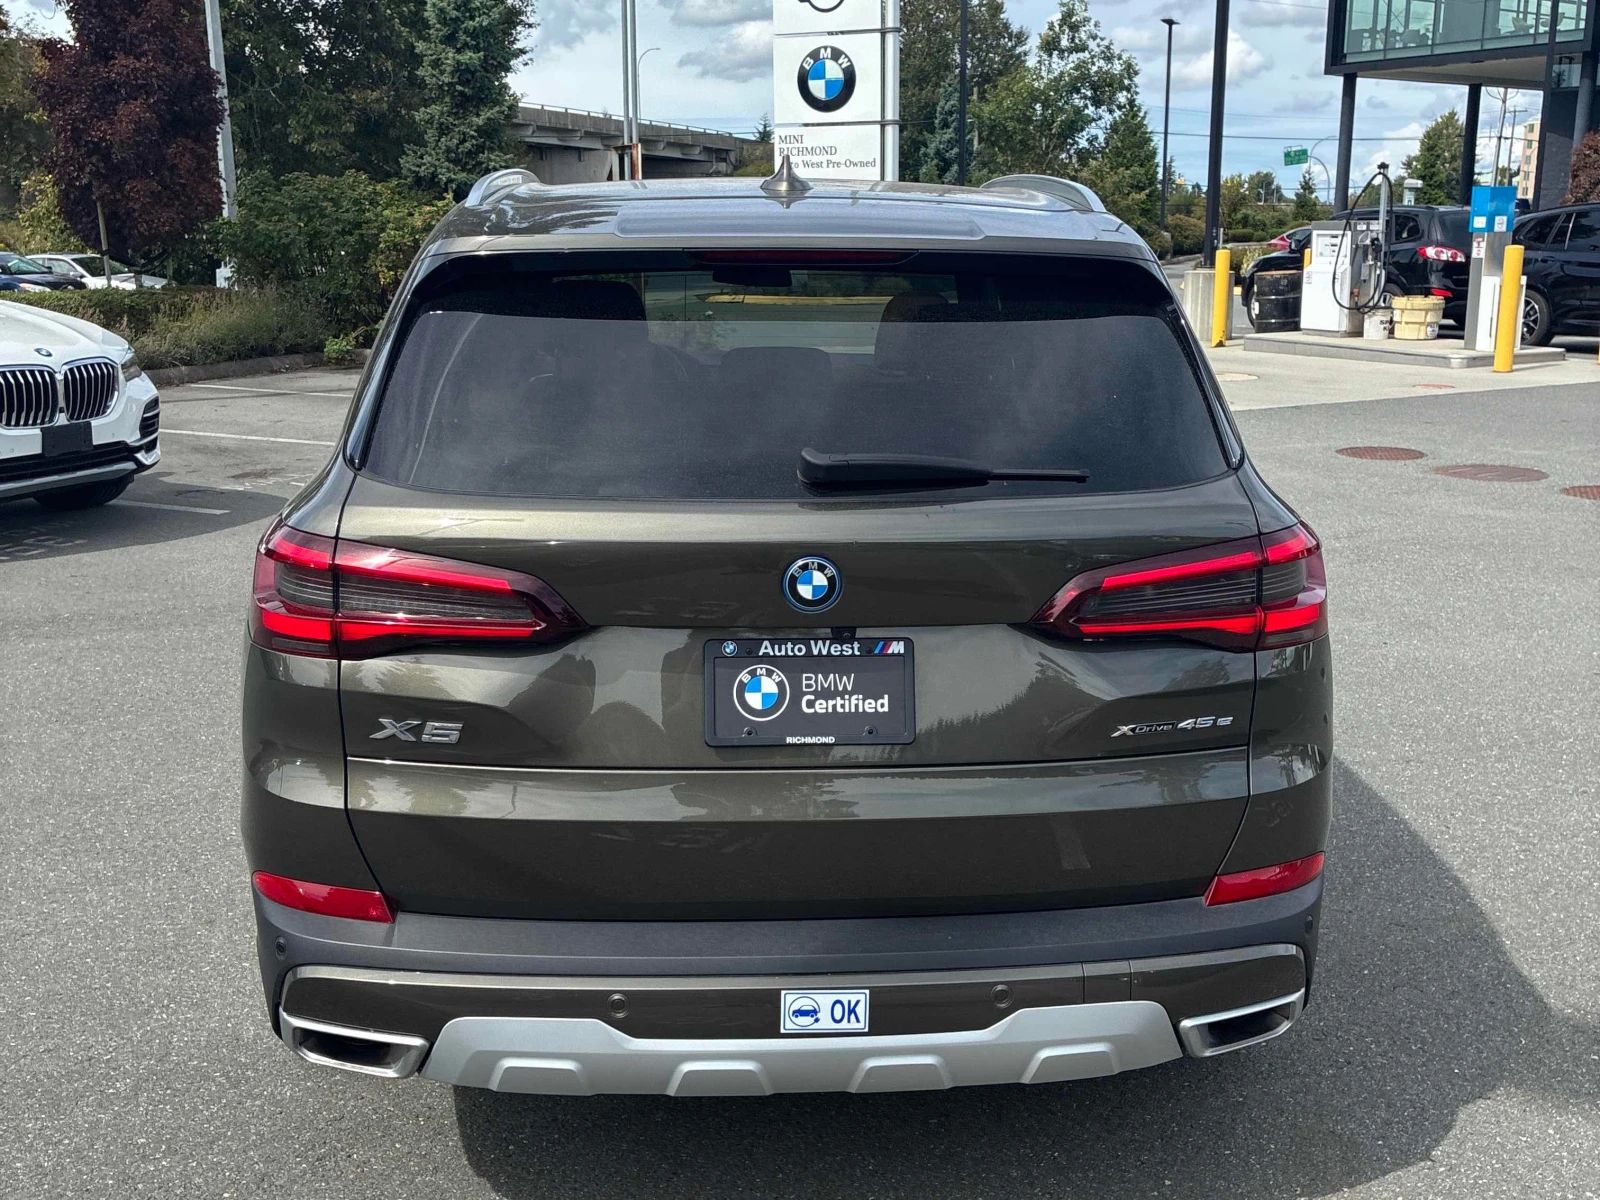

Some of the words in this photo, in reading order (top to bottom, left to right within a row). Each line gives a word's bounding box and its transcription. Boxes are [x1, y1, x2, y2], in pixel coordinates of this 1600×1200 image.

[778, 134, 804, 145] MINI
[778, 146, 837, 156] RICHMOND
[801, 159, 824, 169] West
[826, 158, 876, 168] Pre-Owned
[758, 640, 806, 656] Auto
[810, 640, 861, 656] West
[802, 673, 855, 691] BMW
[801, 694, 889, 713] Certified
[368, 718, 464, 744] X5
[786, 736, 835, 744] RICHMOND
[830, 999, 861, 1024] OK
